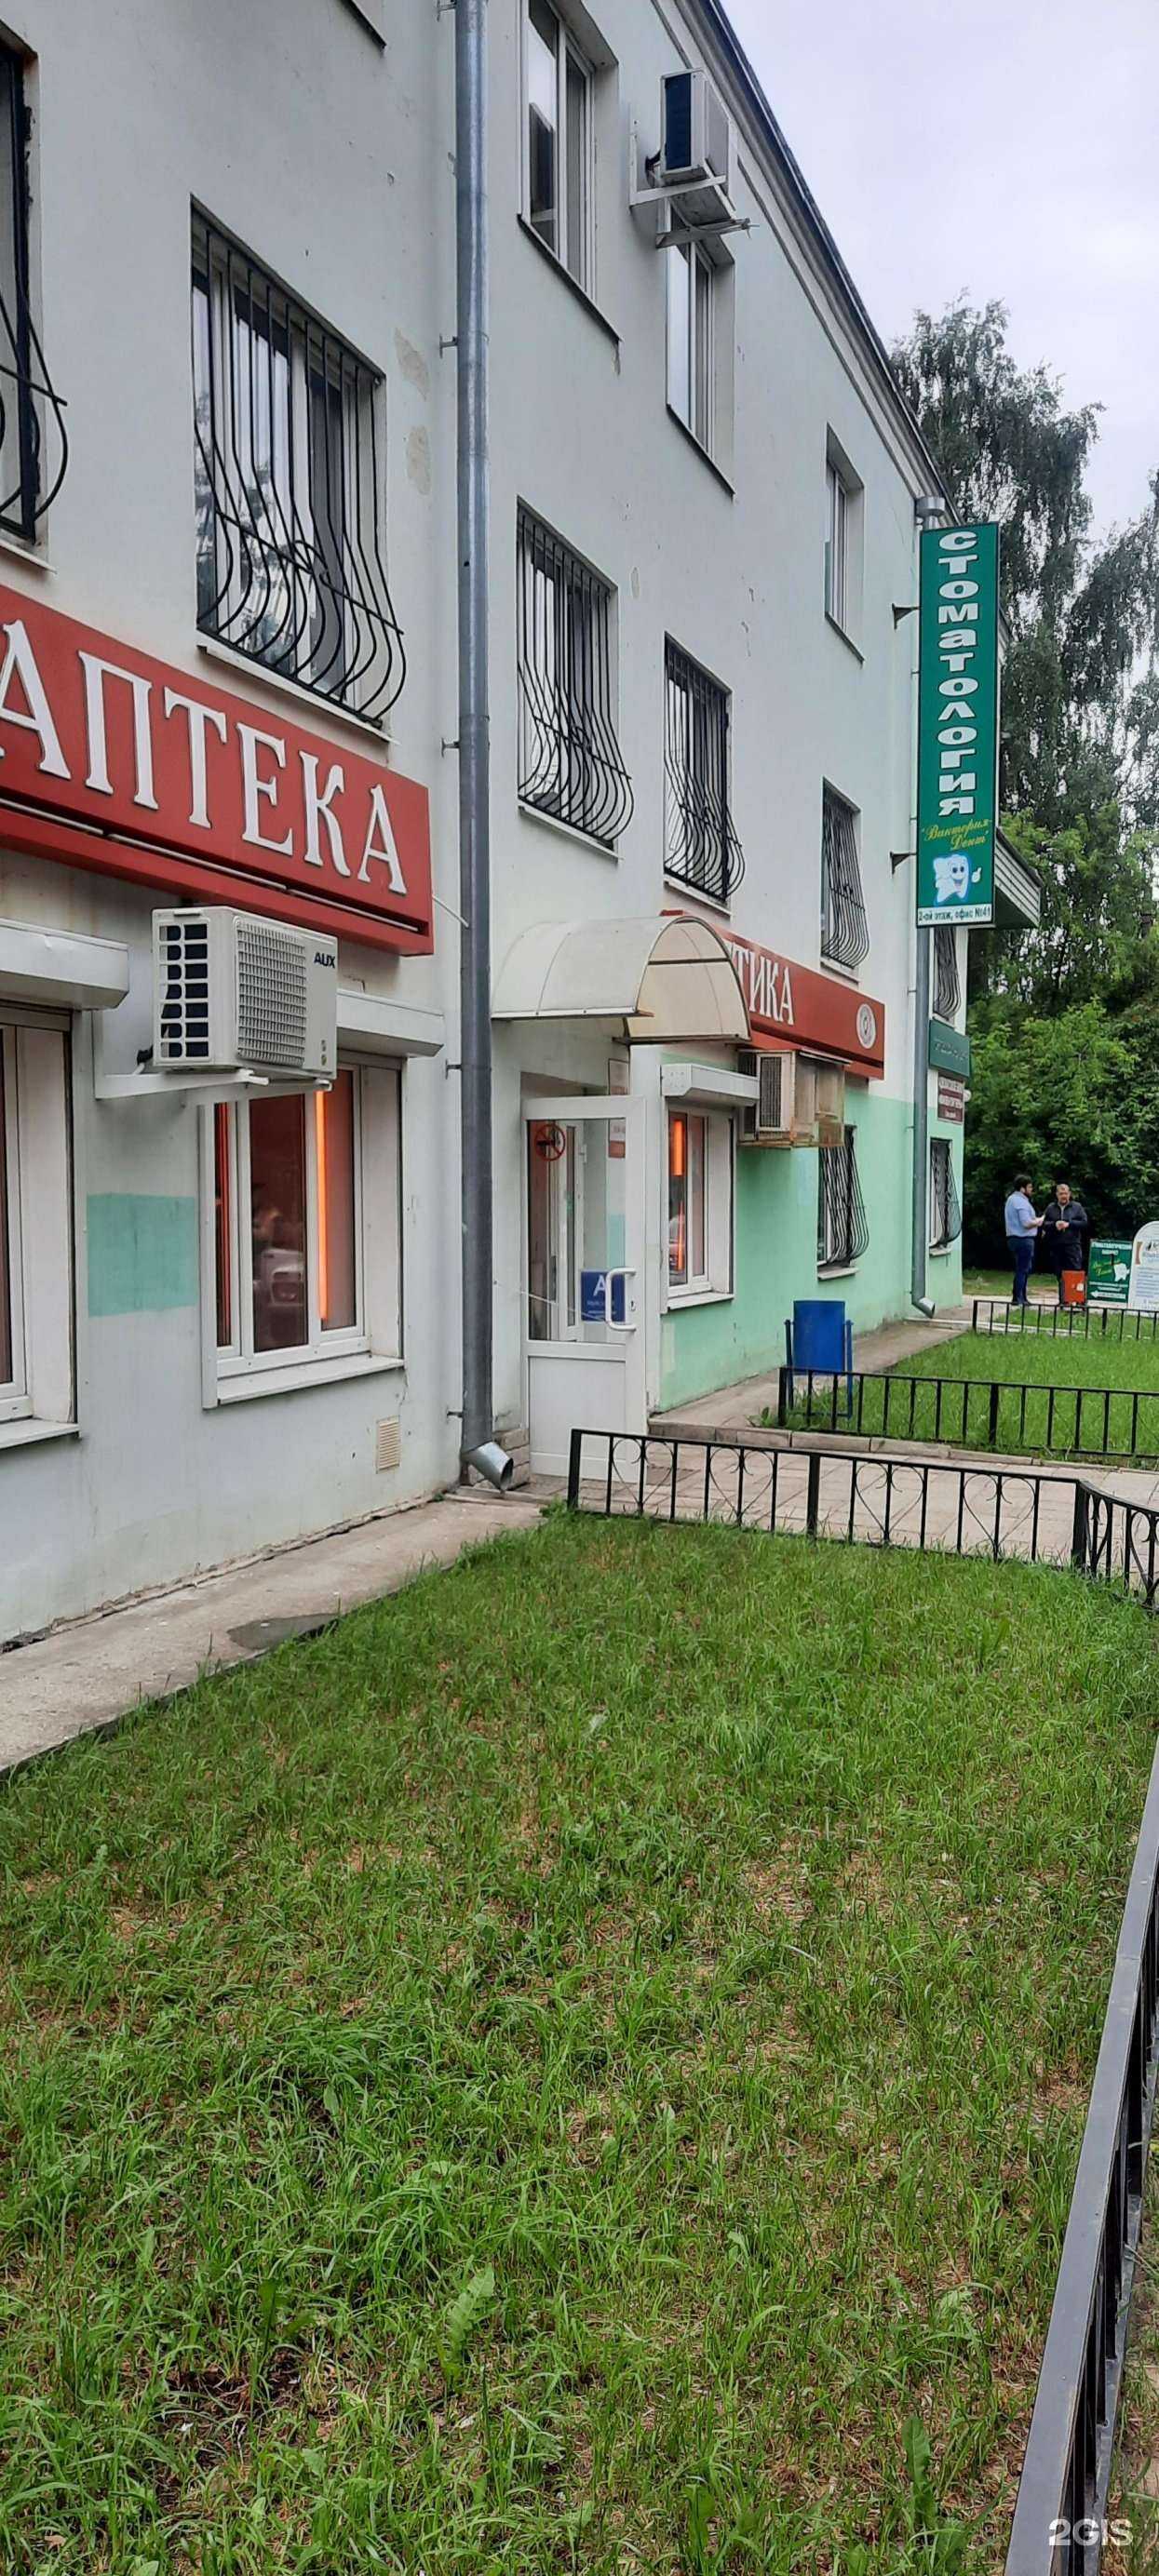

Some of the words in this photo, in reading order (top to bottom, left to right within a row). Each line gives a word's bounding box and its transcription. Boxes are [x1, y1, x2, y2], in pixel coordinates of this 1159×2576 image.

[0, 619, 407, 895] АПТЕКА
[314, 951, 336, 969] AUX
[723, 938, 794, 1026] ТИКА
